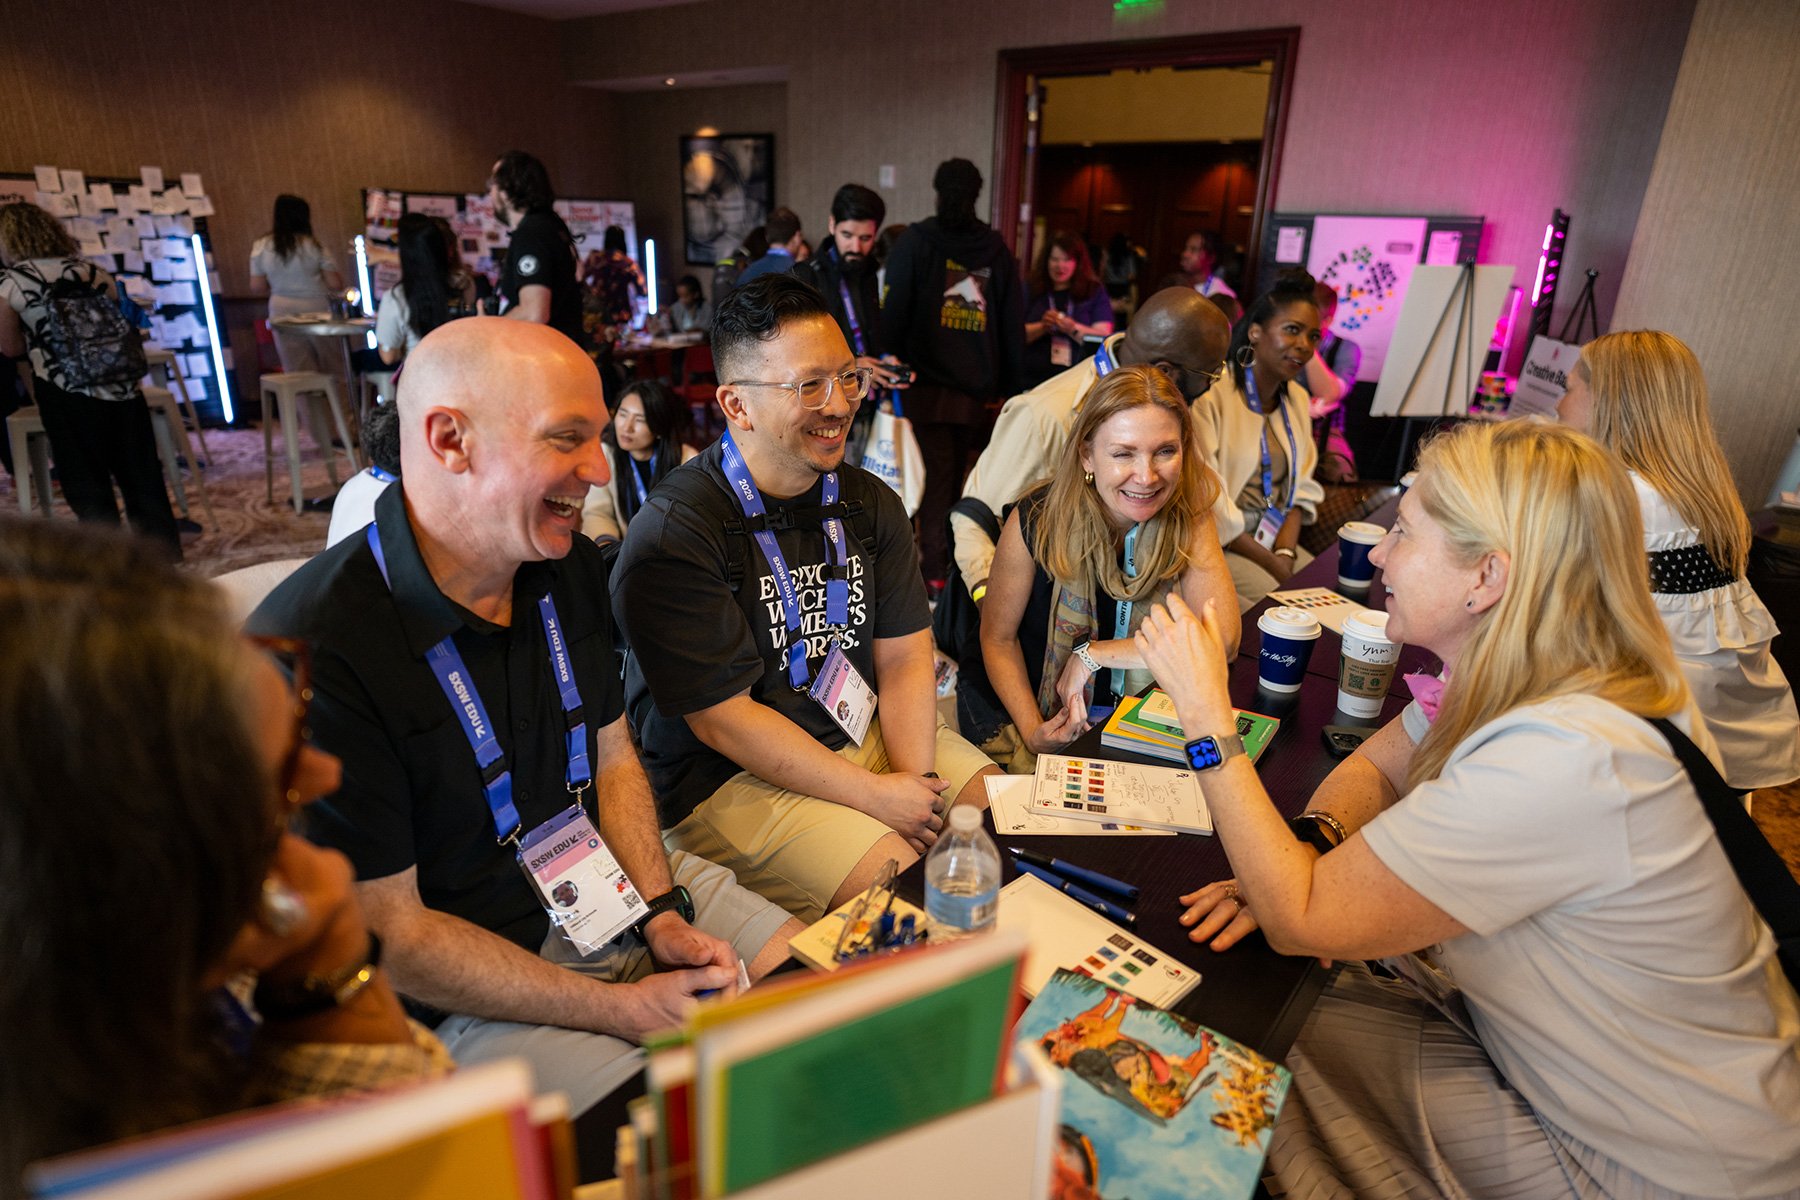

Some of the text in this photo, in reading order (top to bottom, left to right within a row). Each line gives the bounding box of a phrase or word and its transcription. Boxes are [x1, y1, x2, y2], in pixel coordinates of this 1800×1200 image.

[739, 478, 755, 501] 2026
[773, 556, 792, 599] SXSW EDU
[550, 629, 569, 683] SXSW EDU
[448, 671, 482, 729] SXSW EDU
[822, 685, 832, 702] SXSW
[530, 840, 571, 869] SXSW EDU
